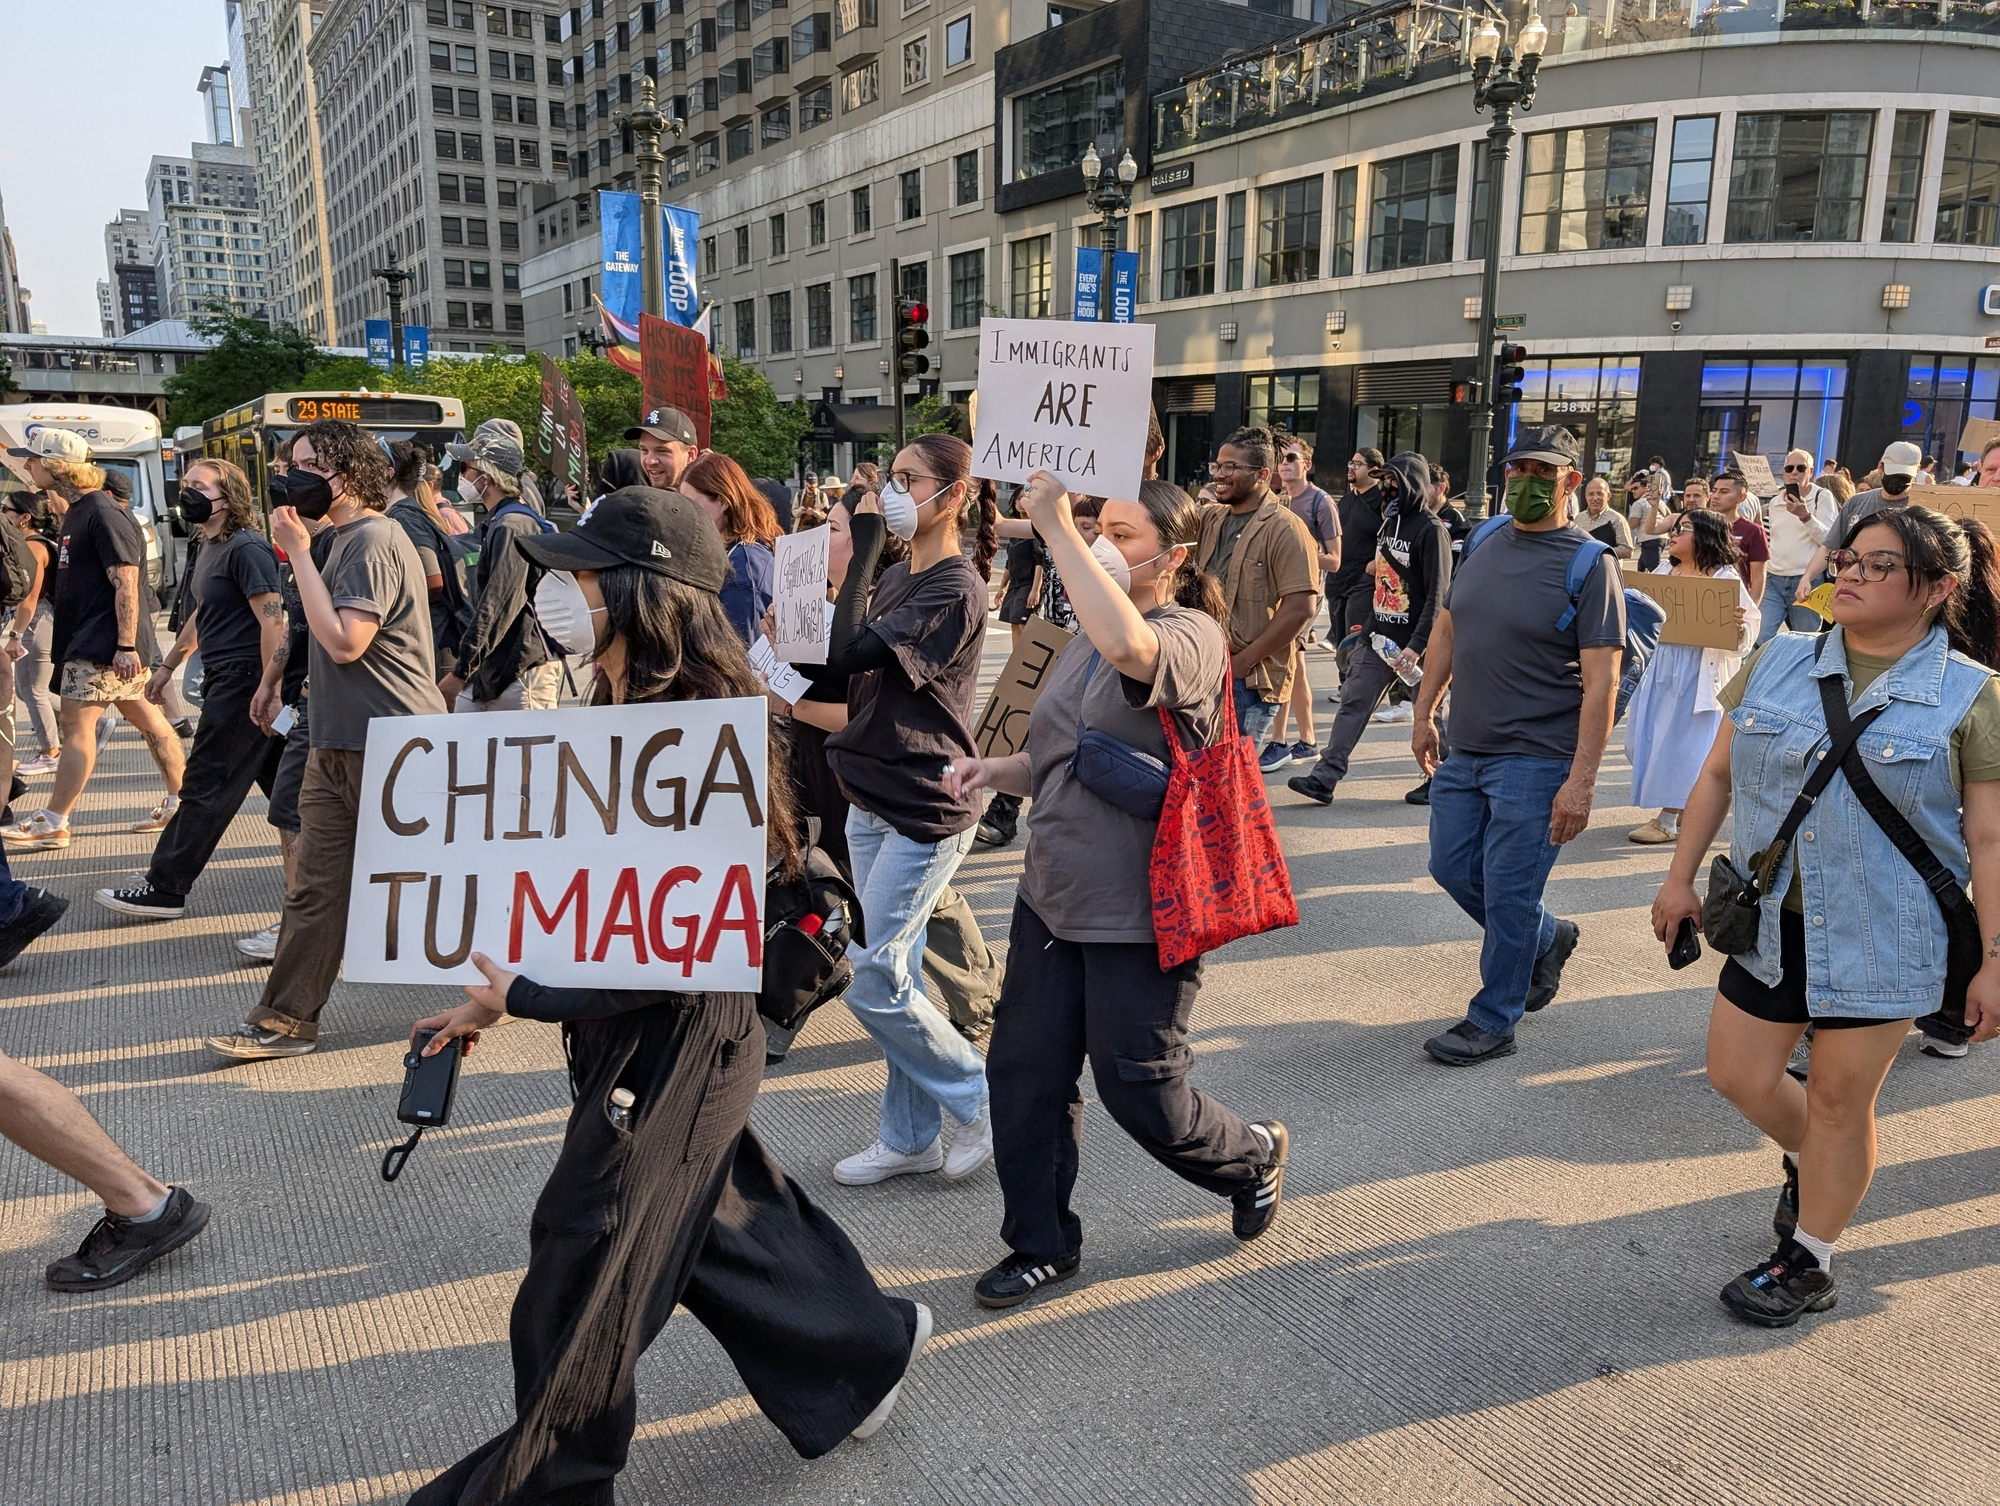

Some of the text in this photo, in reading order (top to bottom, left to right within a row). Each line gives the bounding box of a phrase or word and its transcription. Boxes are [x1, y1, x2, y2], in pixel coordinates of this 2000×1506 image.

[1152, 168, 1190, 187] RAISED
[605, 262, 639, 273] GATEWAY
[614, 251, 630, 261] THE
[668, 260, 689, 312] LOOP
[1078, 283, 1096, 293] ONE'S
[1079, 273, 1097, 283] EVERY
[1120, 270, 1128, 285] THE
[1077, 307, 1096, 318] HOOD
[646, 321, 702, 366] HISTORY
[990, 329, 1133, 372] IMMIGRANTS
[297, 401, 361, 420] 29 STATE
[538, 381, 554, 455] CHINGA
[1033, 380, 1097, 428] ARE
[1553, 402, 1591, 413] 238 N
[555, 422, 566, 450] LA
[568, 420, 582, 487] MIGRA
[982, 433, 1097, 476] AMERICA
[381, 723, 765, 846] CHINGA
[369, 864, 763, 978] TU MAGA
